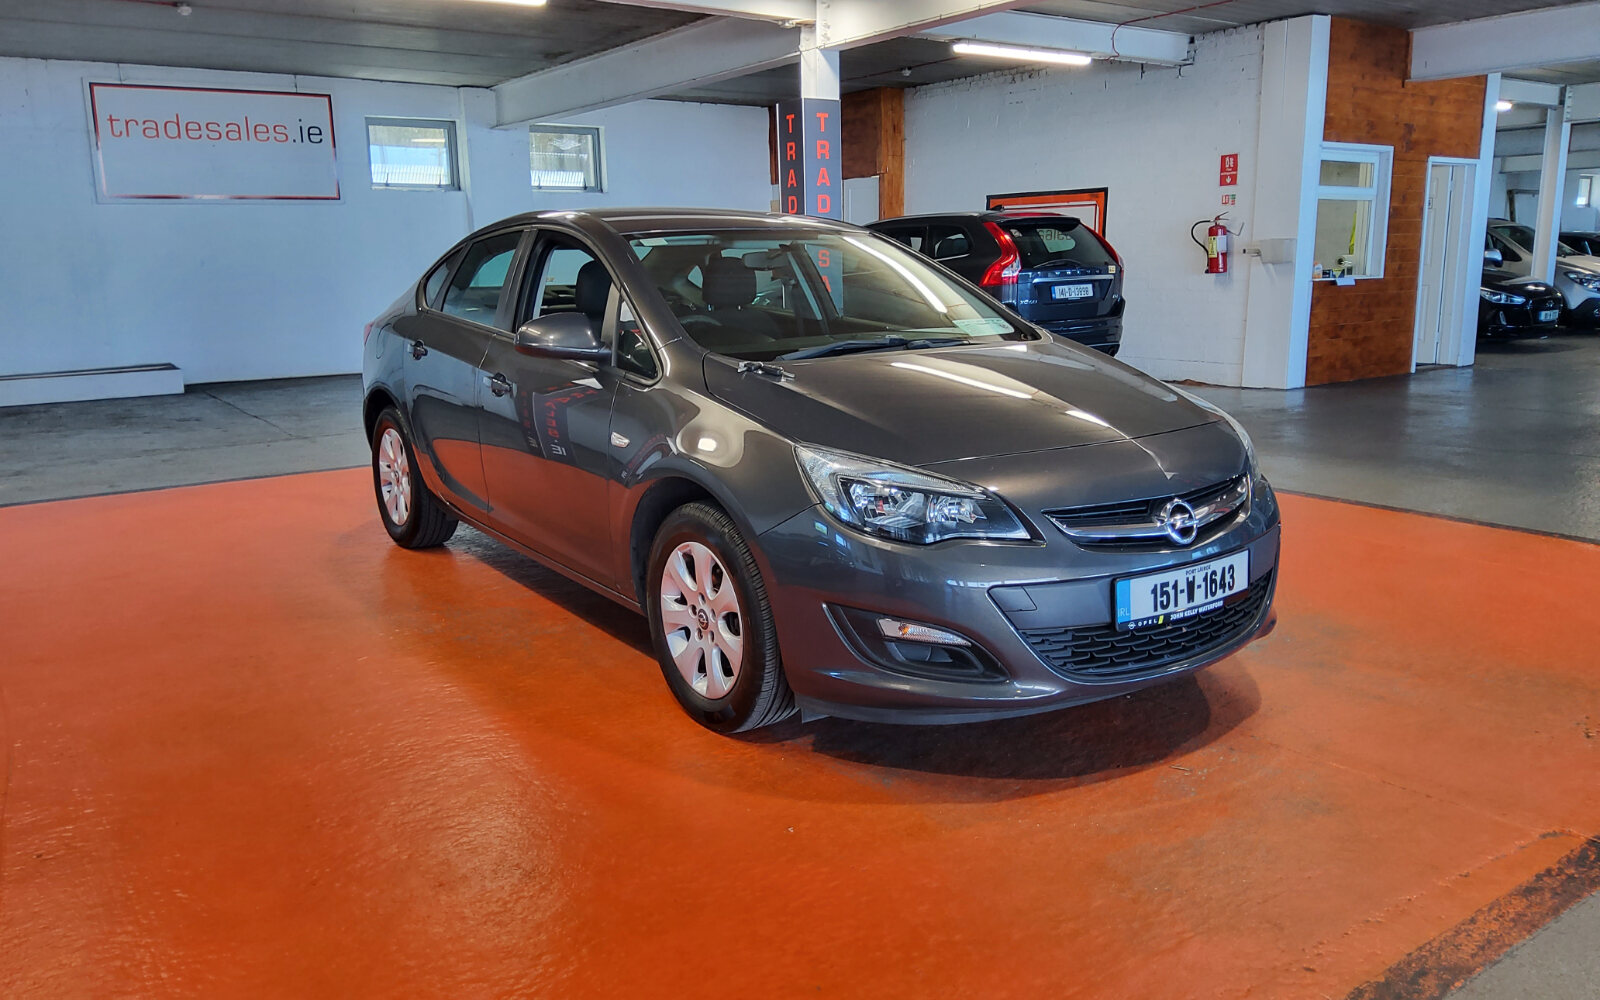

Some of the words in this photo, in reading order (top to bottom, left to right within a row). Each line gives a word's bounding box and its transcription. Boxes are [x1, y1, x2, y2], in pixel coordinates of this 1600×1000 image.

[107, 113, 323, 144] tradesales.ie
[1151, 563, 1235, 613] 151-W-1643
[1117, 608, 1130, 618] IRL
[1170, 612, 1184, 621] JOHN
[1184, 608, 1198, 617] KELLY
[1198, 600, 1224, 613] WATERFORD
[1138, 618, 1157, 627] OPEL
